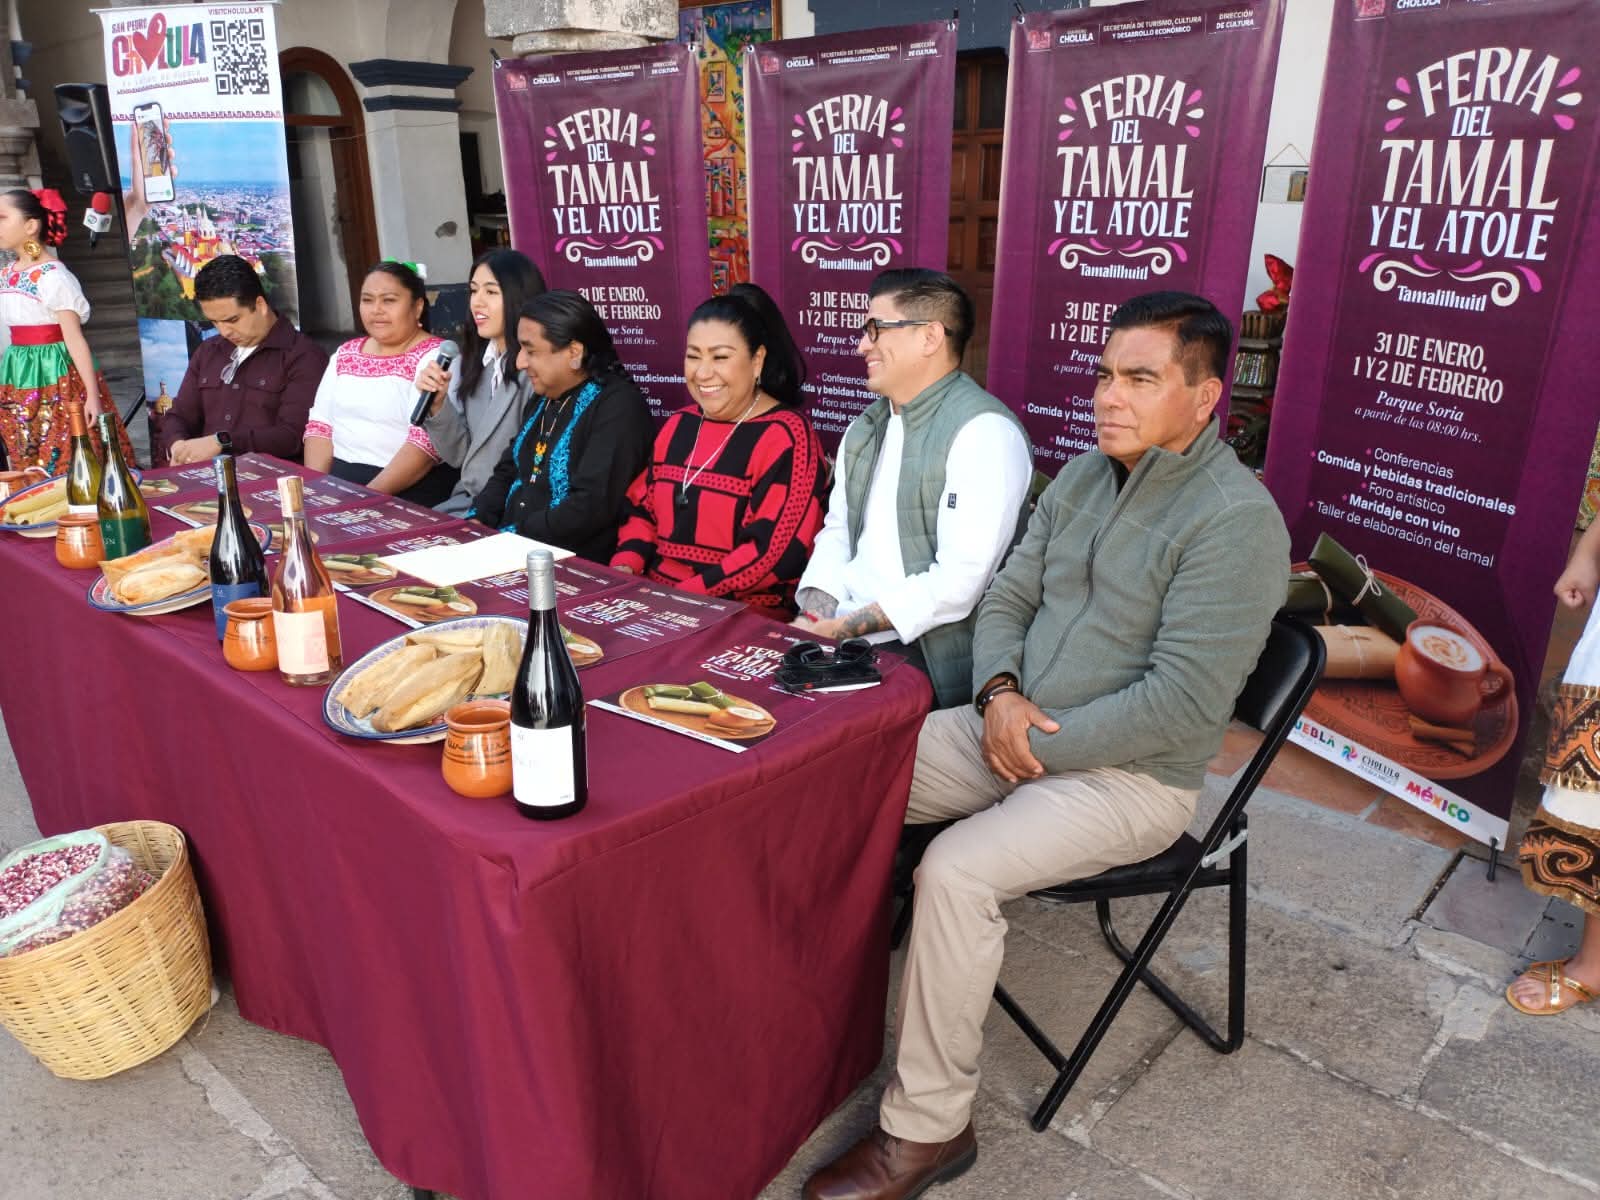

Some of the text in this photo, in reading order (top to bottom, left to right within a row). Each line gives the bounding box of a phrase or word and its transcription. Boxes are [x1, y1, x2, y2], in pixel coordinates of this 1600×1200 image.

[1103, 20, 1136, 32] SECRETARÍA
[1174, 15, 1202, 26] CULTURA
[1216, 19, 1254, 30] DE CULTURA
[1219, 9, 1254, 20] DIRECCIÓN
[112, 23, 126, 34] SAN
[1060, 32, 1094, 44] CHOLULA
[1116, 29, 1154, 39] DESARROLLO
[786, 58, 814, 68] CHOLULA
[532, 76, 560, 86] CHOLULA
[1416, 46, 1561, 118] FERIA
[1080, 74, 1187, 129] FERIA
[806, 94, 888, 142] FERIA
[1450, 106, 1494, 137] DEL
[557, 107, 638, 152] FERIA
[1110, 119, 1143, 144] DEL
[587, 142, 613, 162] DEL
[834, 133, 858, 154] DEL
[792, 153, 903, 201] TAMAL
[1056, 144, 1194, 199] TAMAL
[1380, 138, 1560, 211] TAMAL
[547, 161, 660, 205] TAMAL
[552, 204, 663, 235] Y EL ATOLE
[793, 202, 902, 234] Y EL ATOLE
[1054, 200, 1192, 238] Y EL ATOLE
[1369, 205, 1555, 261] Y EL ATOLE
[592, 286, 606, 302] DE
[608, 286, 649, 303] ENERO,
[809, 291, 869, 310] 31 DE ENER
[1396, 285, 1488, 312] Tamalilhuitl
[611, 304, 662, 320] FEBRERO
[799, 310, 804, 326] 1
[824, 310, 838, 328] DE
[1064, 301, 1080, 320] 31
[1082, 302, 1101, 322] DE
[621, 325, 644, 336] Soria
[816, 332, 847, 347] Parque
[1050, 323, 1056, 340] 1
[1080, 324, 1098, 345] DE
[1070, 349, 1101, 366] Parqu
[1374, 332, 1488, 374] 31 DE ENERO,
[633, 374, 688, 384] tradicionales
[1053, 364, 1096, 376] a partir de
[1353, 356, 1361, 376] 1
[1391, 361, 1416, 387] DE
[1417, 366, 1504, 404] FEBRERO
[801, 383, 816, 393] ida
[816, 386, 822, 395] y
[822, 385, 855, 398] bebidas
[811, 408, 858, 422] Maridaje co
[822, 398, 868, 411] Foro artístic
[1027, 402, 1096, 423] Comida y bebi
[1376, 390, 1465, 422] Parque Soria
[822, 423, 848, 433] elabor
[1069, 425, 1090, 438] Foro
[1354, 407, 1482, 444] a partir de las 08:00 hrs.
[1055, 435, 1098, 452] Maridaje
[1054, 450, 1066, 460] de
[1374, 447, 1454, 480] Conferencias
[1317, 450, 1517, 516] Comida y bebidas tradicionales
[1368, 481, 1446, 515] Foro artístico
[1349, 494, 1461, 538] Maridaje con vino
[1316, 500, 1495, 568] Taller de elaboración del tamal
[1295, 720, 1336, 748] UEBLA
